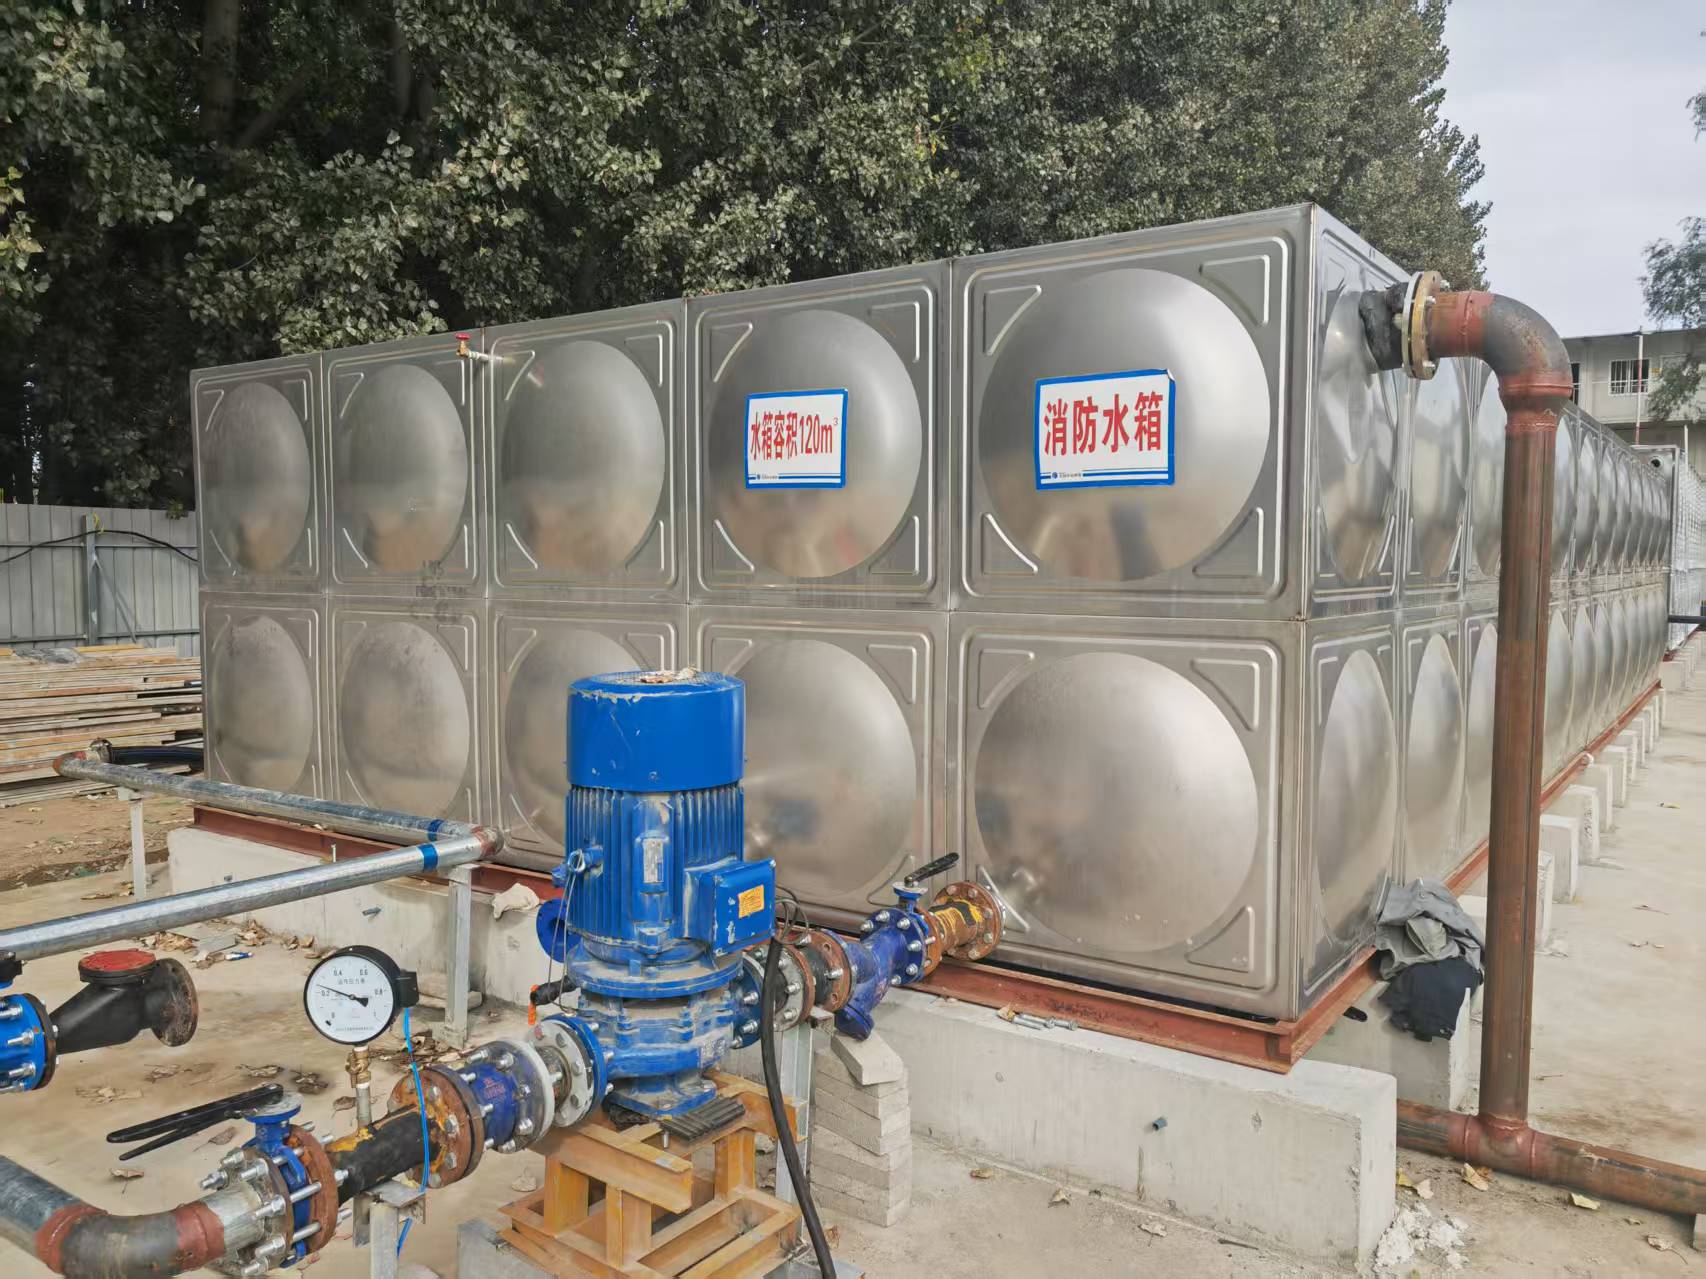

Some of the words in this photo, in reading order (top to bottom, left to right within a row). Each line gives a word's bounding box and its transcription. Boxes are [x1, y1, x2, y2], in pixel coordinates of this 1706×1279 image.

[1043, 391, 1164, 456] 消防水箱
[333, 968, 343, 976] 0.4
